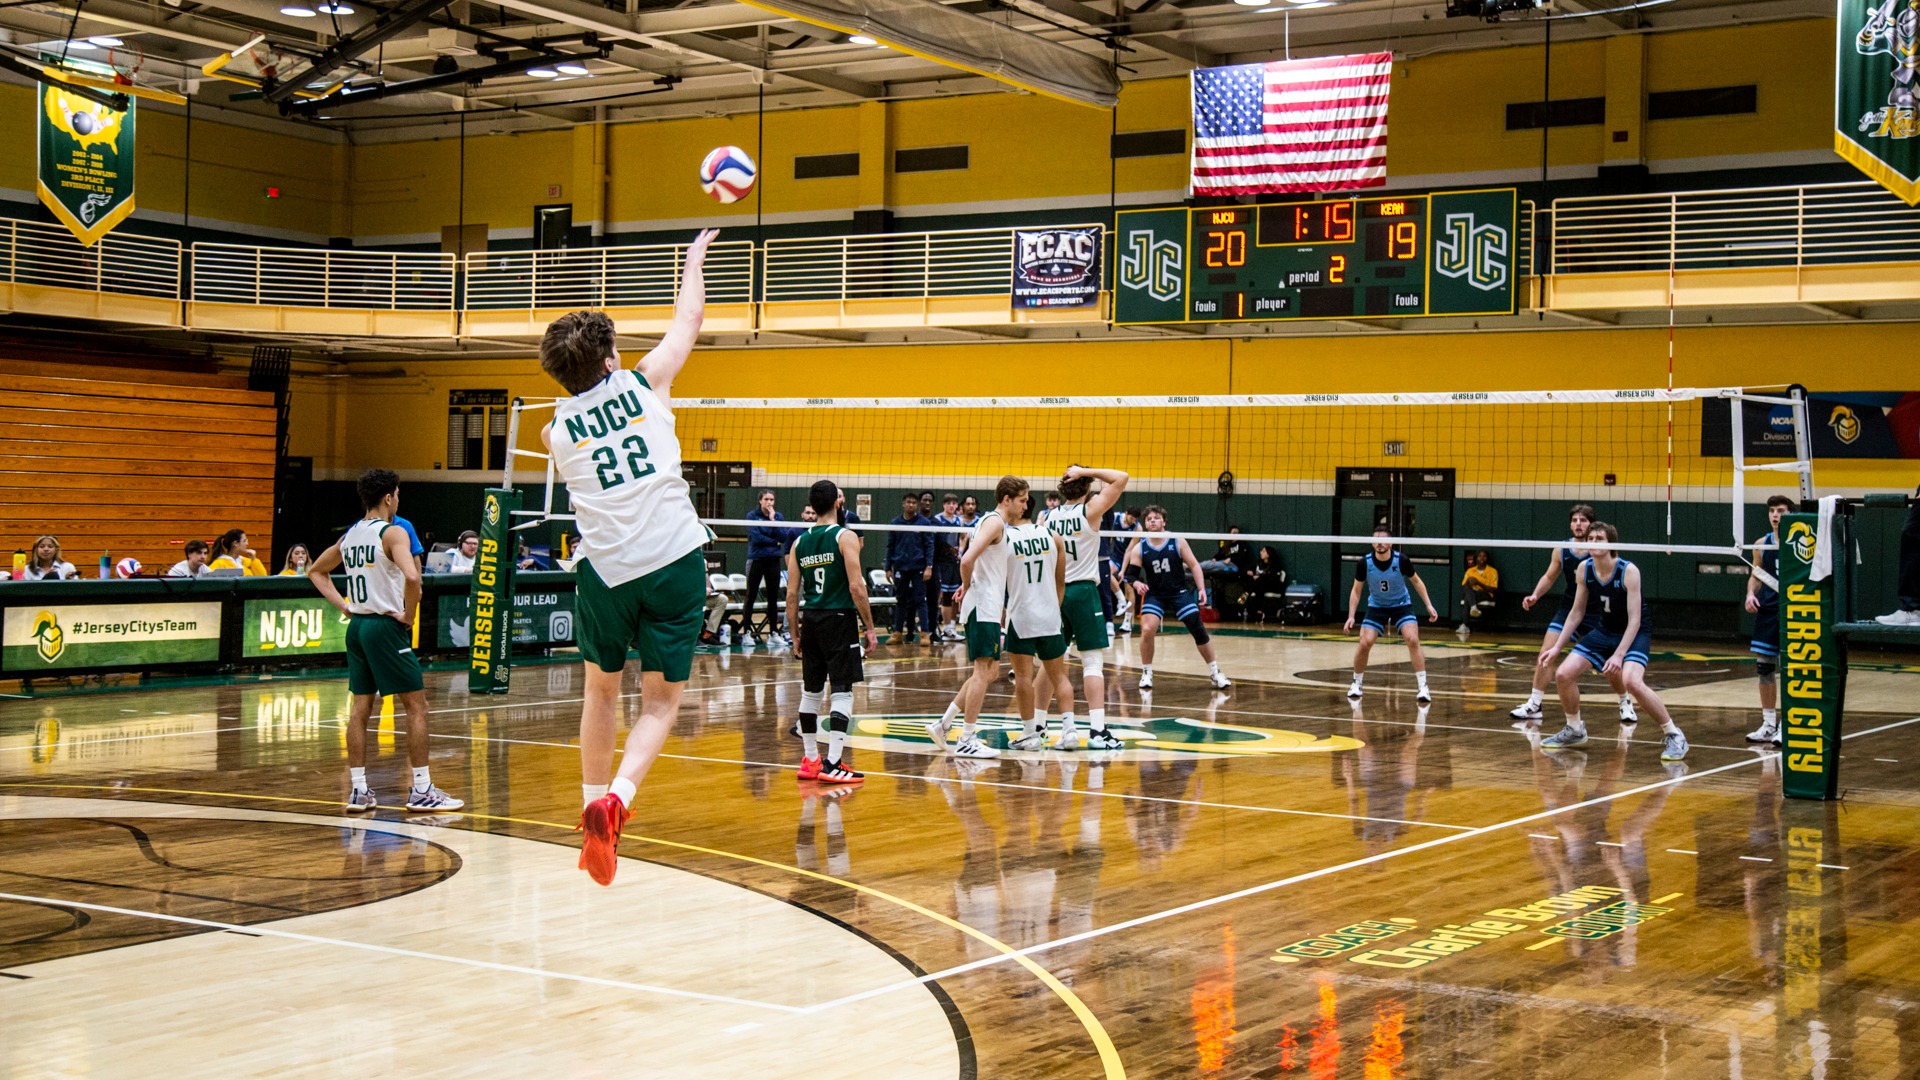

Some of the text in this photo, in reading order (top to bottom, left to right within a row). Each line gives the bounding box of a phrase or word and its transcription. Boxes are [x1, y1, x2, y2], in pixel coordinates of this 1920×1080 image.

[61, 180, 91, 190] DIVISION
[84, 176, 105, 184] PLACE
[1212, 212, 1235, 224] NJCU
[1380, 202, 1405, 216] KEAN
[1296, 203, 1351, 240] 1:15
[1022, 233, 1092, 265] ECAC
[1206, 230, 1246, 267] 20
[1387, 222, 1416, 259] 19
[1289, 270, 1320, 286] period
[1330, 255, 1345, 283] 2
[1195, 301, 1217, 312] fouls
[1237, 292, 1244, 318] 1
[1256, 297, 1286, 312] player
[1395, 294, 1419, 307] fouls
[565, 389, 644, 444] NJCU
[1763, 432, 1793, 440] Division
[591, 434, 656, 490] 22
[1013, 537, 1050, 557] NJCU
[1064, 540, 1078, 561] 4
[1024, 560, 1044, 584] 17
[1152, 558, 1171, 574] 24
[346, 575, 368, 604] 10
[813, 567, 825, 594] 9
[1380, 580, 1389, 592] 3
[472, 539, 498, 675] JERSEY CITY
[533, 594, 558, 606] LEAD
[1600, 595, 1611, 613] 7
[72, 619, 197, 635] #JerseyCitysTeam
[260, 608, 323, 649] NJCU
[1786, 583, 1824, 773] JERSEY CITY
[1347, 885, 1630, 969] Charlie Brown
[1539, 901, 1675, 939] COURT
[1275, 920, 1418, 959] COACH
